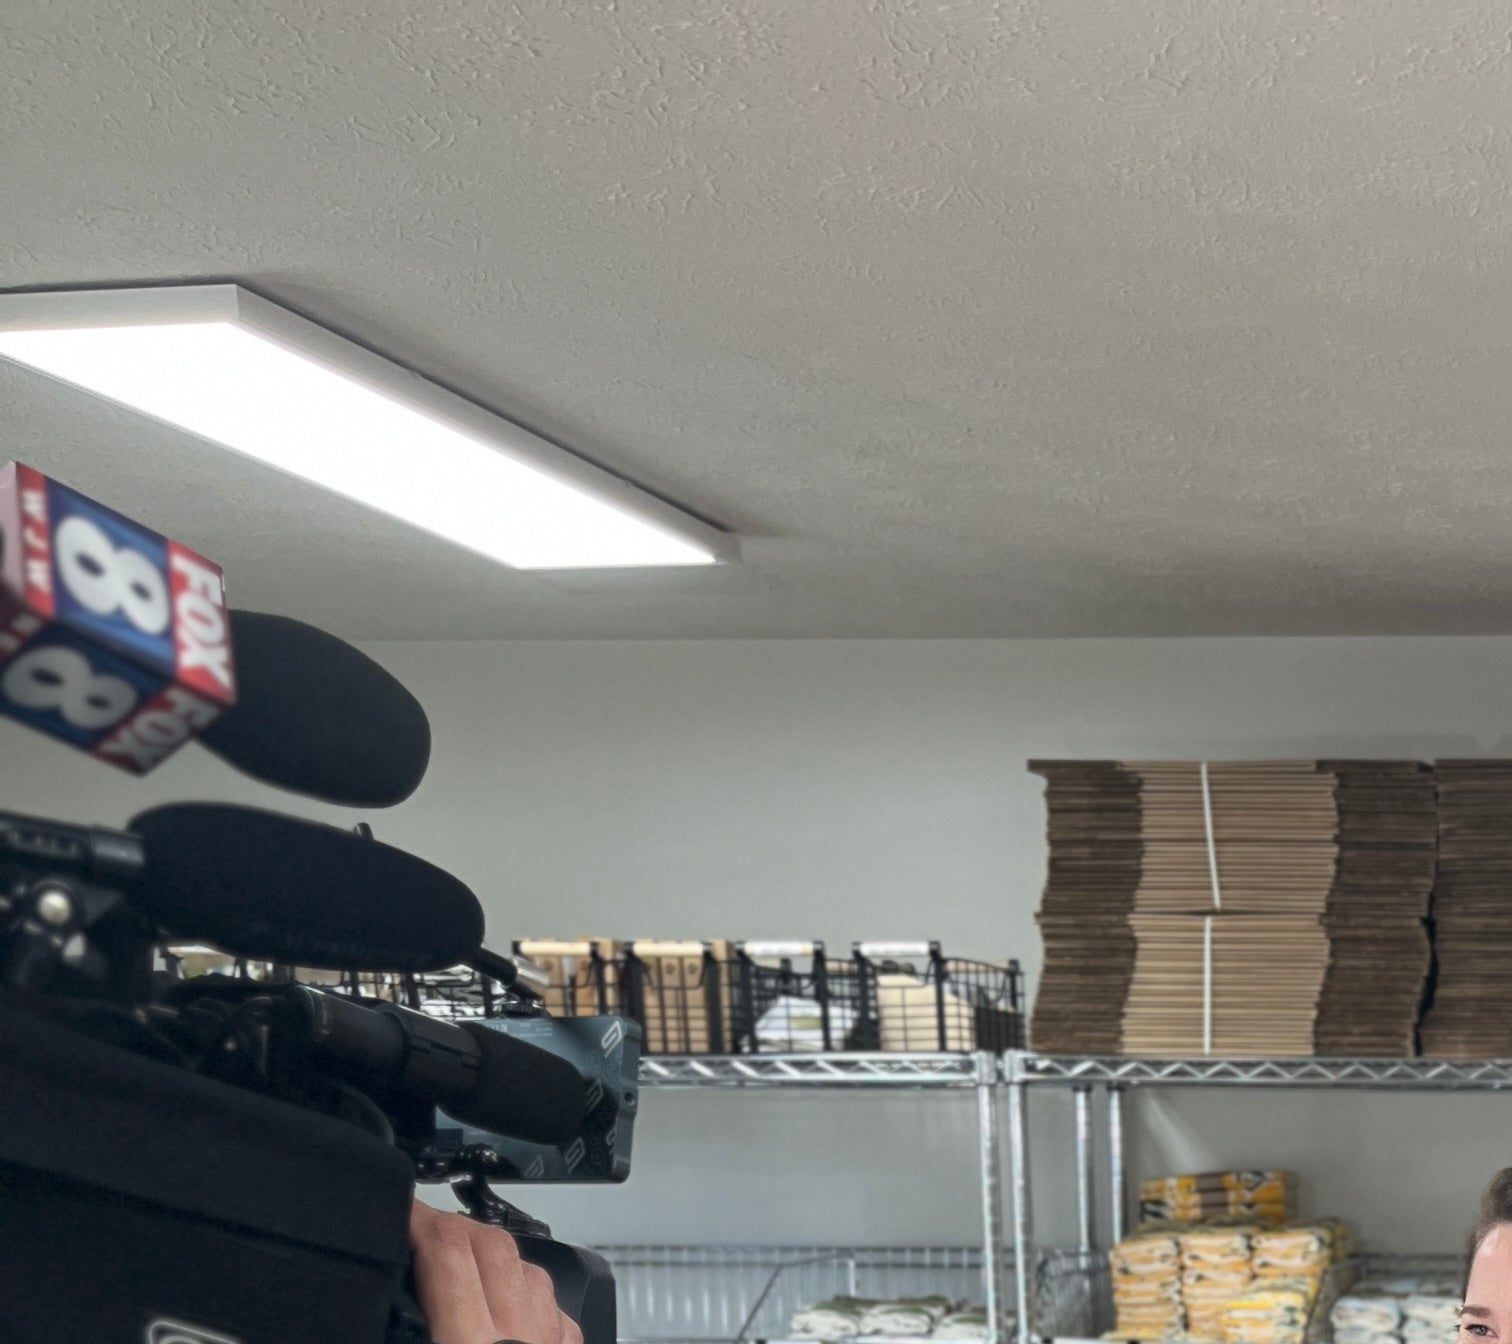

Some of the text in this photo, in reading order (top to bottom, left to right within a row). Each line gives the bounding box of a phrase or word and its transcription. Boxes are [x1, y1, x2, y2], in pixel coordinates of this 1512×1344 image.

[56, 515, 169, 635] 8
[170, 554, 232, 689] FOX
[3, 645, 137, 730] 8
[100, 687, 216, 769] FOX
